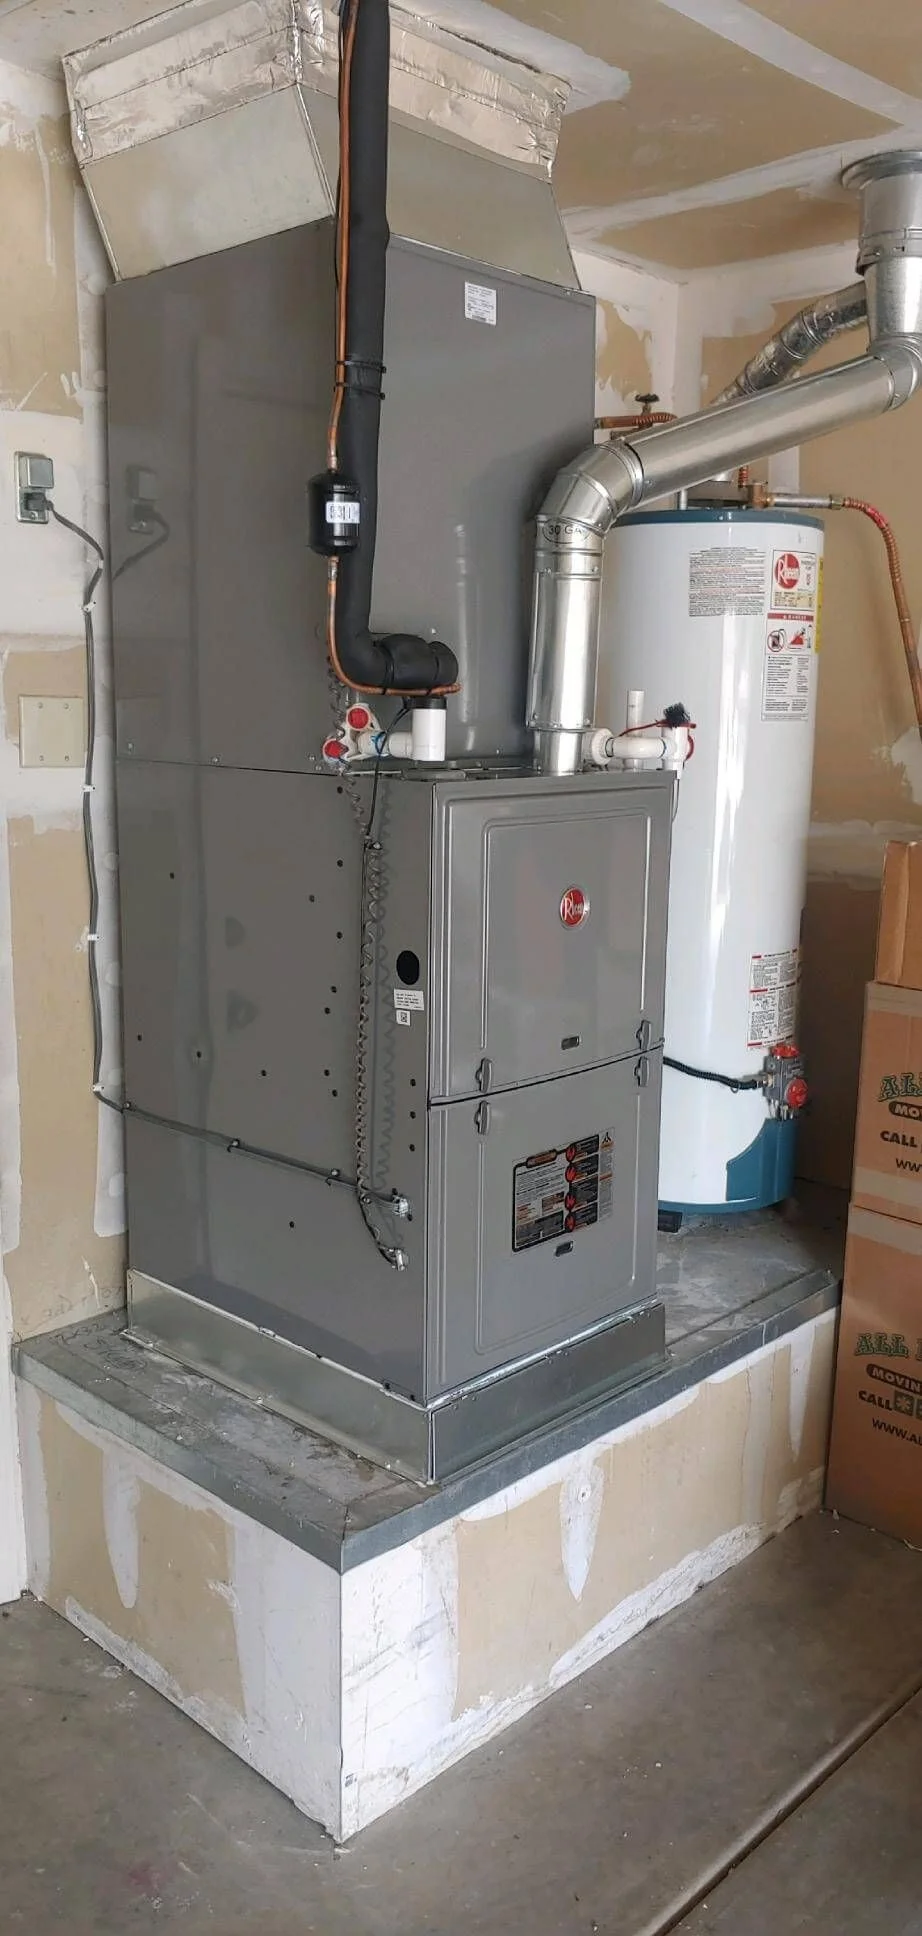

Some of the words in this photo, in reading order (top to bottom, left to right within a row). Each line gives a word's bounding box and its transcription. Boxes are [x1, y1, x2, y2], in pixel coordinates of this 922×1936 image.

[549, 525, 560, 535] 30
[878, 1072, 922, 1101] AL
[880, 1130, 918, 1148] CALL
[855, 1332, 909, 1359] ALL
[859, 1390, 892, 1411] CALL
